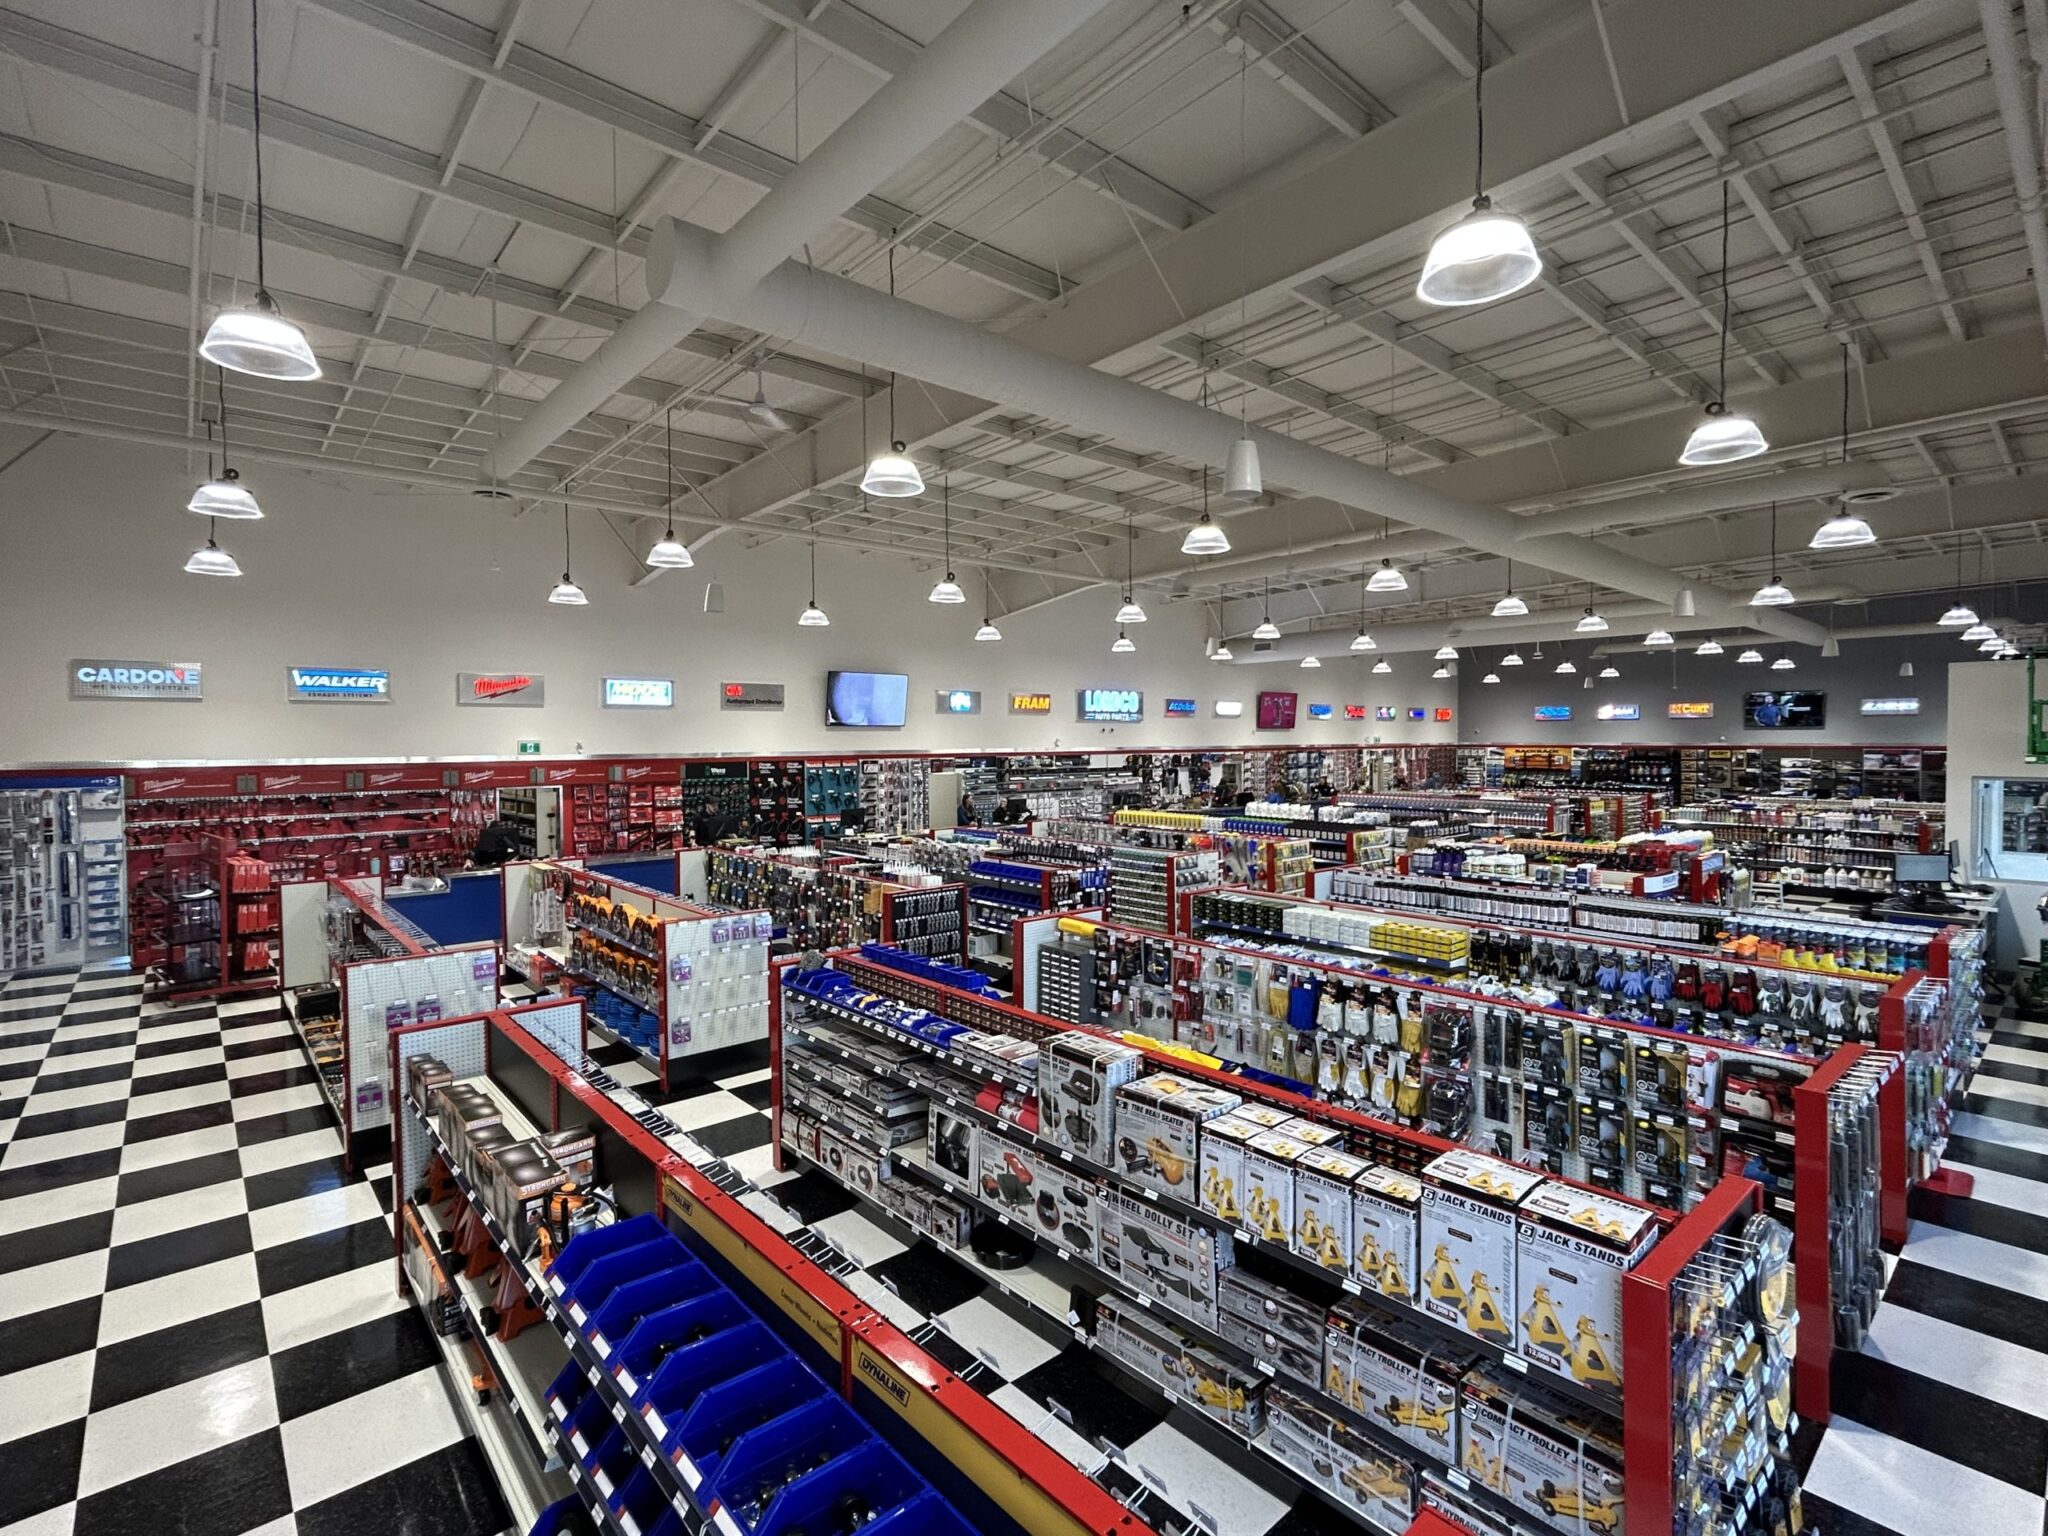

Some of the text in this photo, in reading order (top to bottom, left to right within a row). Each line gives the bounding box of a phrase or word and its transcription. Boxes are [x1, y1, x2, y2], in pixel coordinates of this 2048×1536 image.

[77, 668, 198, 684] CARDONE
[292, 669, 387, 692] WALKER
[1014, 697, 1050, 709] FRAM
[1085, 690, 1138, 712] LORDCO
[144, 778, 186, 791] Milwaukee
[1040, 1059, 1058, 1070] CREEER
[1059, 1057, 1070, 1068] BACK
[1131, 1104, 1143, 1113] TIRE
[1162, 1114, 1184, 1127] SEATER
[981, 1130, 1035, 1160] C-FRAME CREEPER SEAT
[1209, 1137, 1222, 1146] JACK
[1223, 1142, 1242, 1153] STANDS
[1036, 1160, 1046, 1169] ROLL
[1047, 1165, 1064, 1176] AROUND
[1254, 1156, 1266, 1164] JACK
[1268, 1161, 1288, 1174] STANDS
[521, 1174, 566, 1195] STRONGARM
[1306, 1174, 1321, 1183] JACK
[1323, 1180, 1346, 1193] STANDS
[1098, 1188, 1107, 1199] 2
[1423, 1188, 1435, 1199] 6
[1564, 1186, 1648, 1214] JACK STANDS
[1112, 1192, 1141, 1215] WHEEL
[1145, 1209, 1173, 1229] DOLLY
[1176, 1225, 1195, 1239] SET
[1365, 1195, 1382, 1207] JACK
[1384, 1203, 1410, 1218] STANDS
[1438, 1193, 1466, 1209] JACK
[1470, 1203, 1512, 1225] STANDS
[1520, 1224, 1535, 1237] 6
[1538, 1229, 1570, 1248] JACK
[1574, 1242, 1624, 1266] STANDS
[1430, 1302, 1448, 1315] 12,000
[1118, 1328, 1140, 1347] PROFILE
[1143, 1344, 1157, 1357] JACK
[1329, 1331, 1338, 1340] 2
[1341, 1336, 1376, 1358] COMPACT
[1378, 1353, 1411, 1376] TROLLEY
[1528, 1347, 1549, 1363] 12,000
[863, 1360, 906, 1403] DYNALINE
[1269, 1408, 1278, 1417] 2
[1466, 1401, 1477, 1412] 2
[1283, 1415, 1316, 1442] HYDRAULIC
[1340, 1450, 1358, 1466] JACK
[1481, 1409, 1526, 1435] COMPACT
[1528, 1431, 1570, 1459] TROLLEY
[1444, 1508, 1488, 1536] HYDRAULIC
